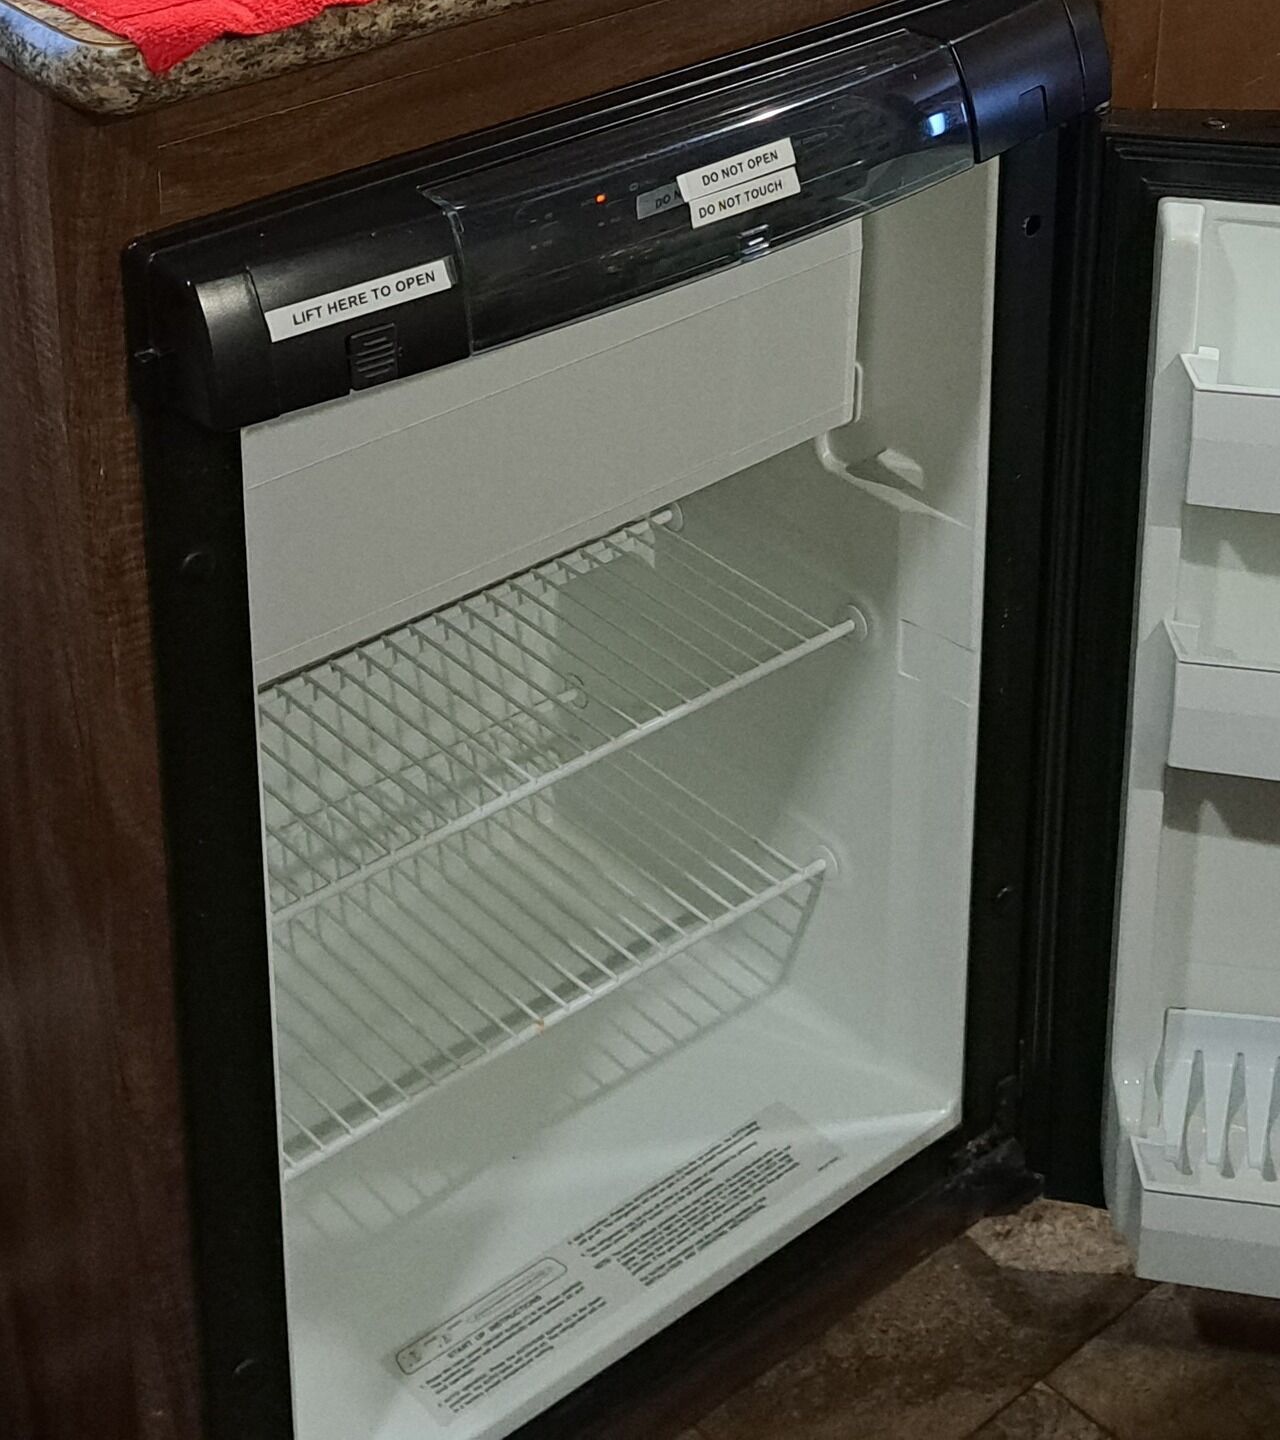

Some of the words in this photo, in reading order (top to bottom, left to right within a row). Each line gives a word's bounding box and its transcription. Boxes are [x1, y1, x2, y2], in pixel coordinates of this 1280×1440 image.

[702, 171, 719, 186] DO
[721, 162, 744, 179] NOT
[747, 150, 778, 169] OPEN
[655, 194, 671, 209] DO
[698, 204, 716, 219] DO
[718, 193, 741, 211] NOT
[744, 179, 783, 202] TOUCH
[292, 305, 323, 326] LIFT
[328, 292, 368, 315] HERE
[371, 284, 391, 300] TO
[395, 270, 436, 292] OPEN
